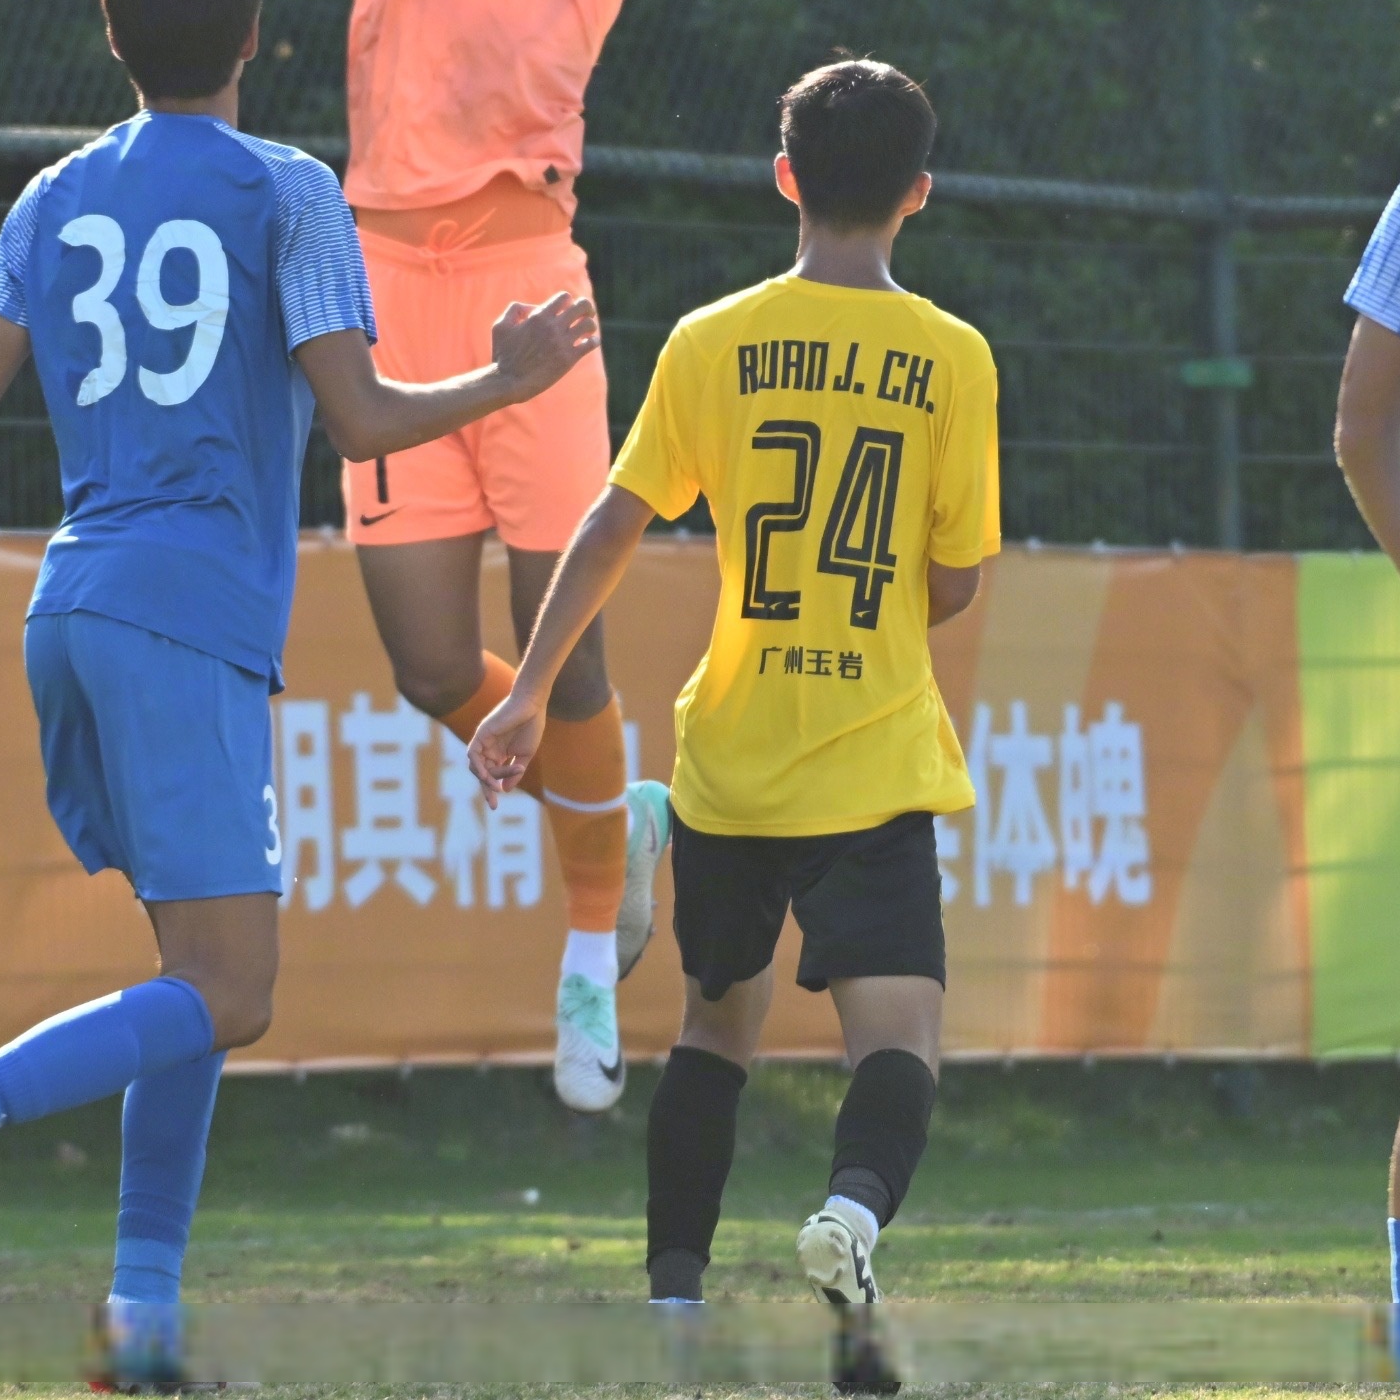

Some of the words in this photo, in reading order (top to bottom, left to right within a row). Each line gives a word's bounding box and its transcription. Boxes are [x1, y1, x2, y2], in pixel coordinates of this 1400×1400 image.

[57, 213, 230, 407] 39
[737, 340, 830, 395] RUAN
[832, 342, 865, 394] J.
[876, 349, 935, 414] CH.
[740, 419, 905, 631] 24
[757, 645, 864, 681] 广州玉岩
[935, 699, 1153, 909] 体魄
